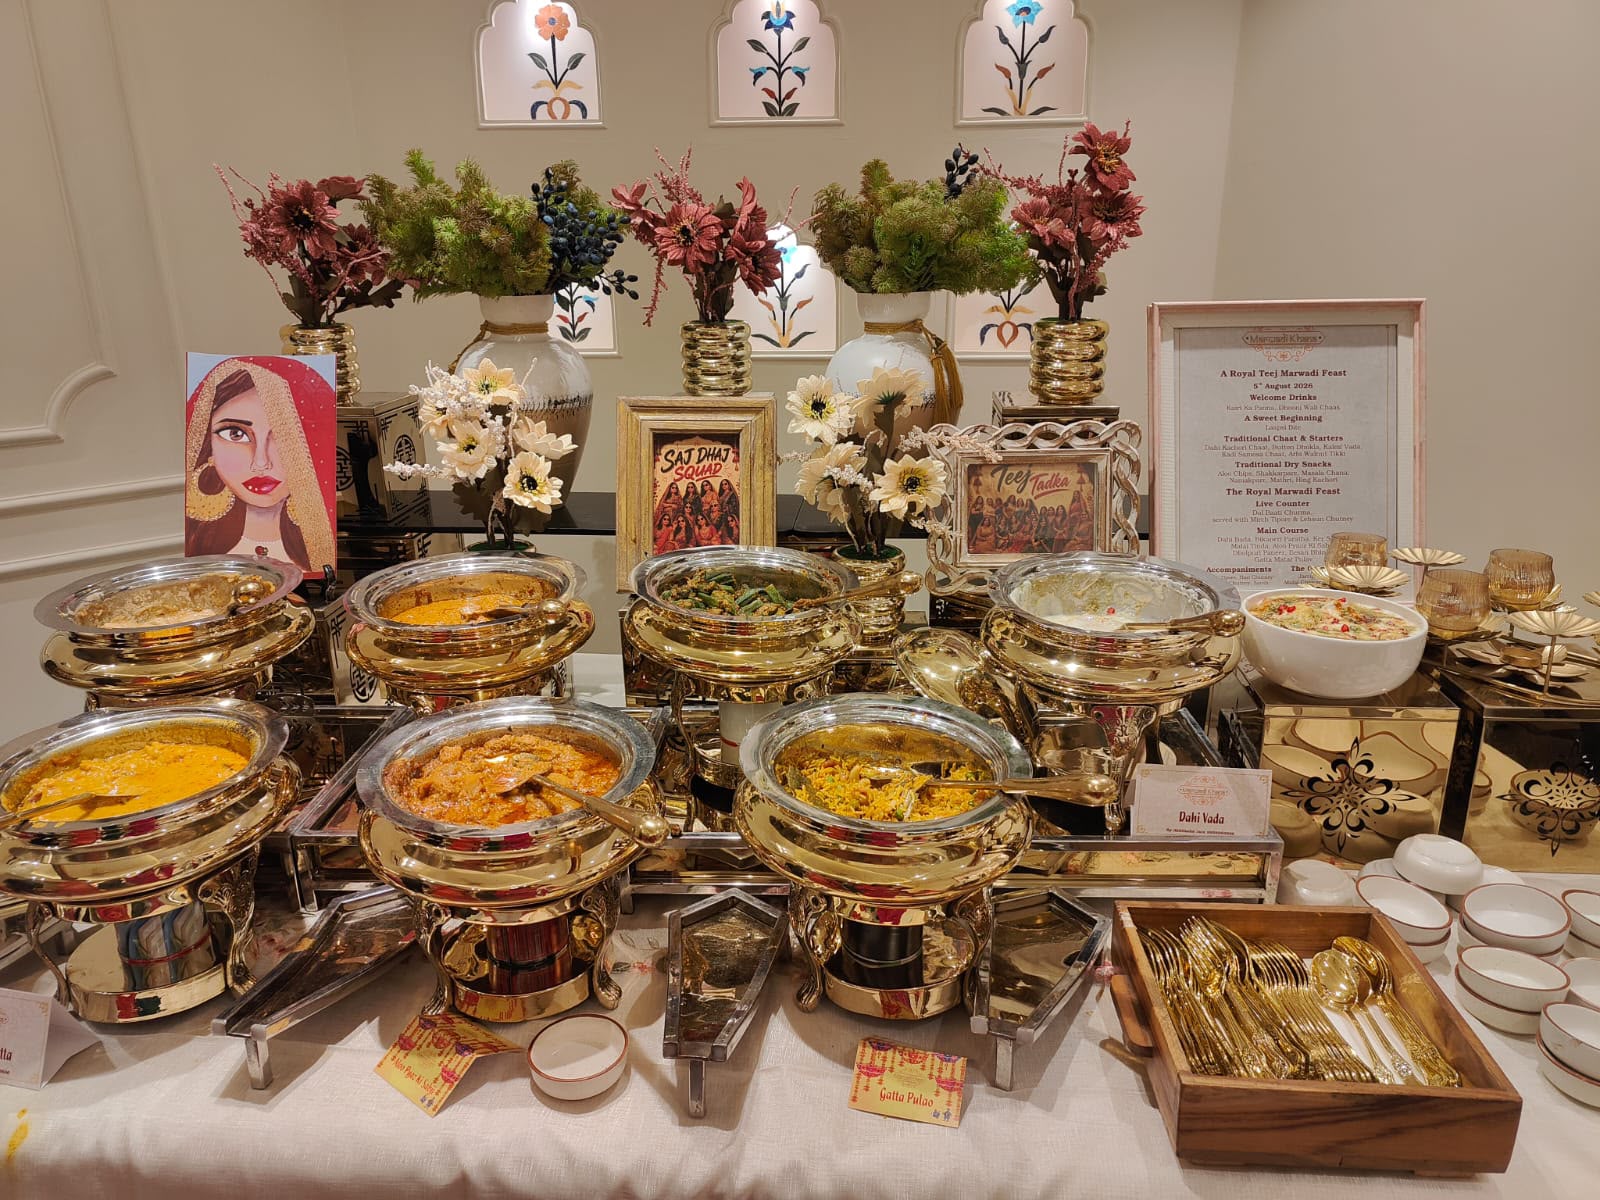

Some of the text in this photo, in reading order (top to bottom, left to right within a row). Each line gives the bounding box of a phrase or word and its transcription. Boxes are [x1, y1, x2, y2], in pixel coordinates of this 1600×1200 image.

[1230, 370, 1255, 378] Royal
[1259, 370, 1278, 378] Teej
[1265, 383, 1290, 391] August
[661, 447, 732, 473] SAJ DHAJ
[1285, 461, 1299, 469] Dry
[673, 463, 723, 482] SQUAD
[991, 464, 1071, 494] Teej Tadka
[1246, 488, 1271, 496] Royal
[1179, 811, 1224, 824] Dahi Vada
[880, 1088, 934, 1107] Gatta Pulao
